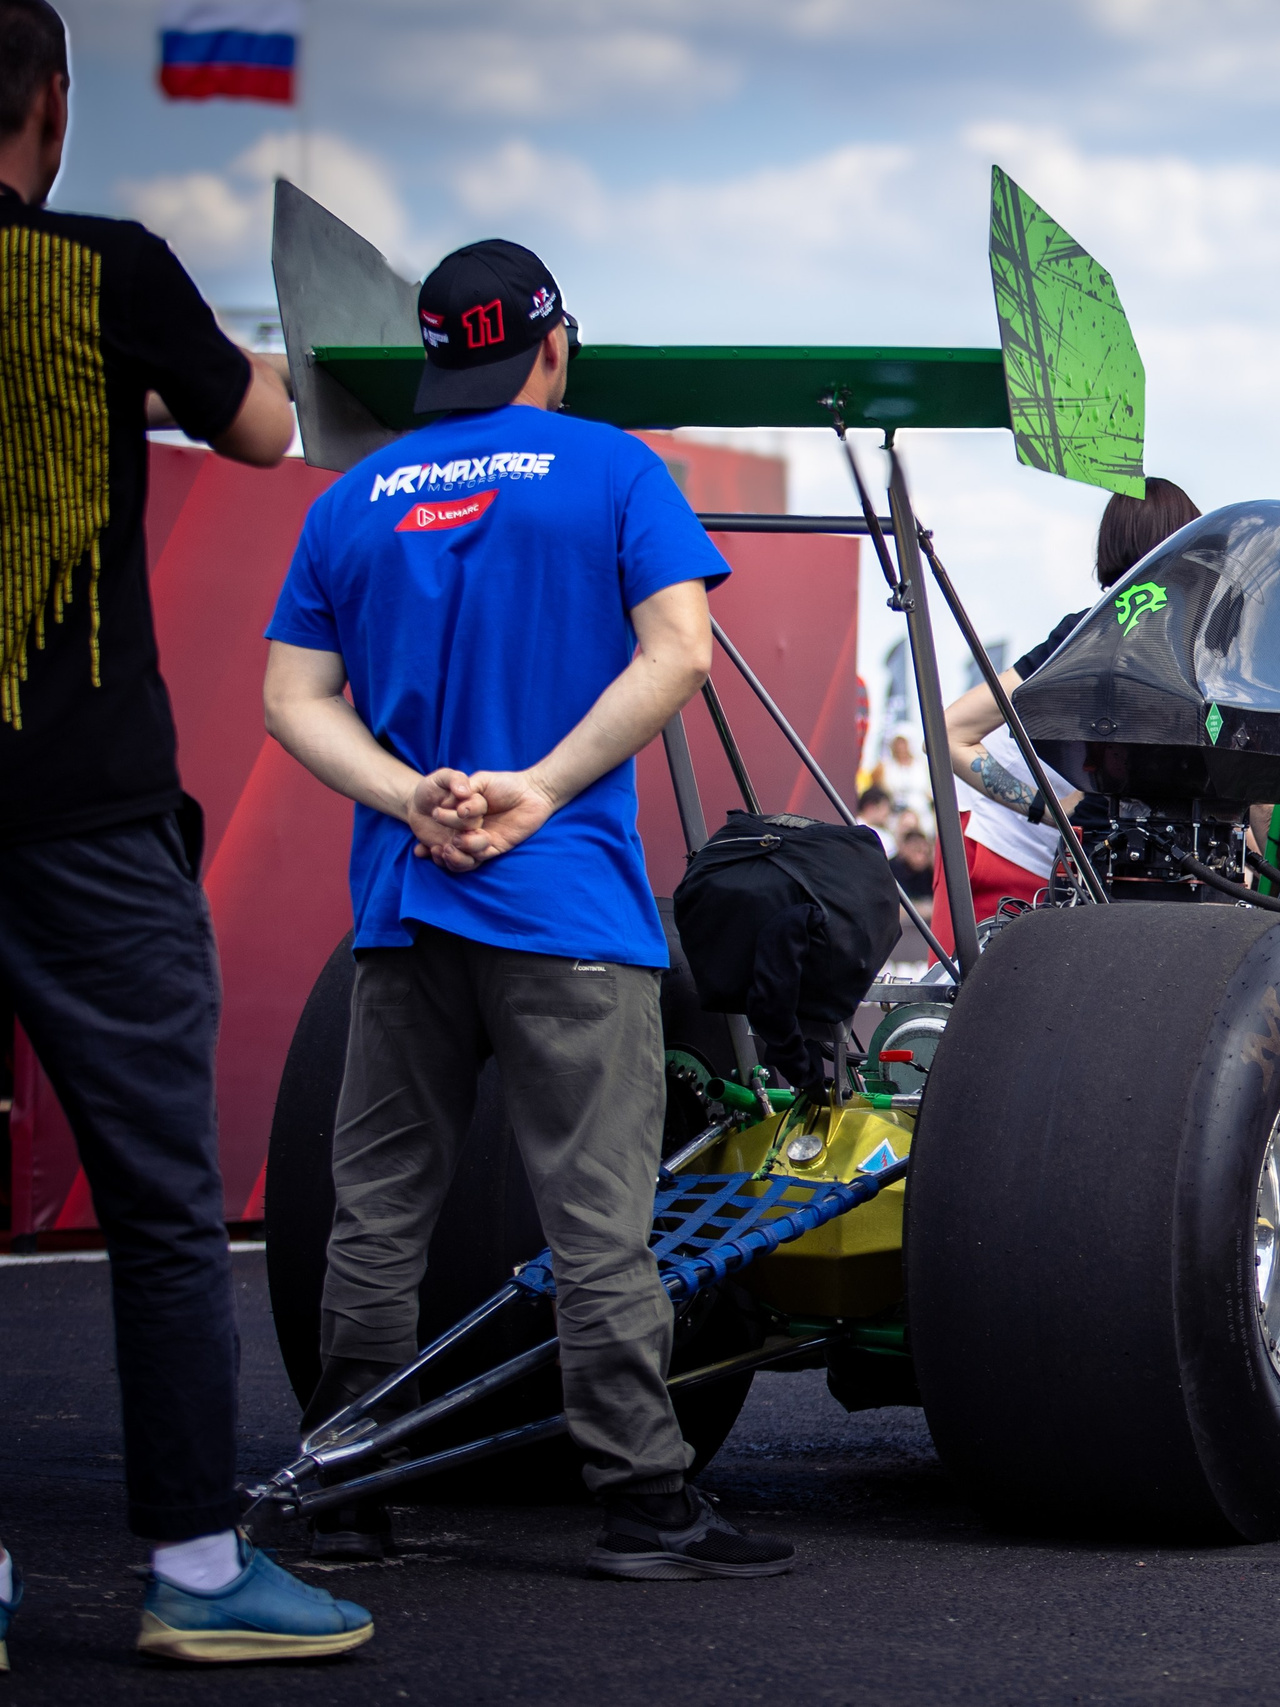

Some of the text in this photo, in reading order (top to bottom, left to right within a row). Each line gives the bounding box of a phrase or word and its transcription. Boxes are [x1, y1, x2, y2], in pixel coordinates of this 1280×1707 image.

[461, 298, 505, 348] 11
[427, 472, 547, 492] MOTORSPORT
[438, 503, 480, 521] LEMARC
